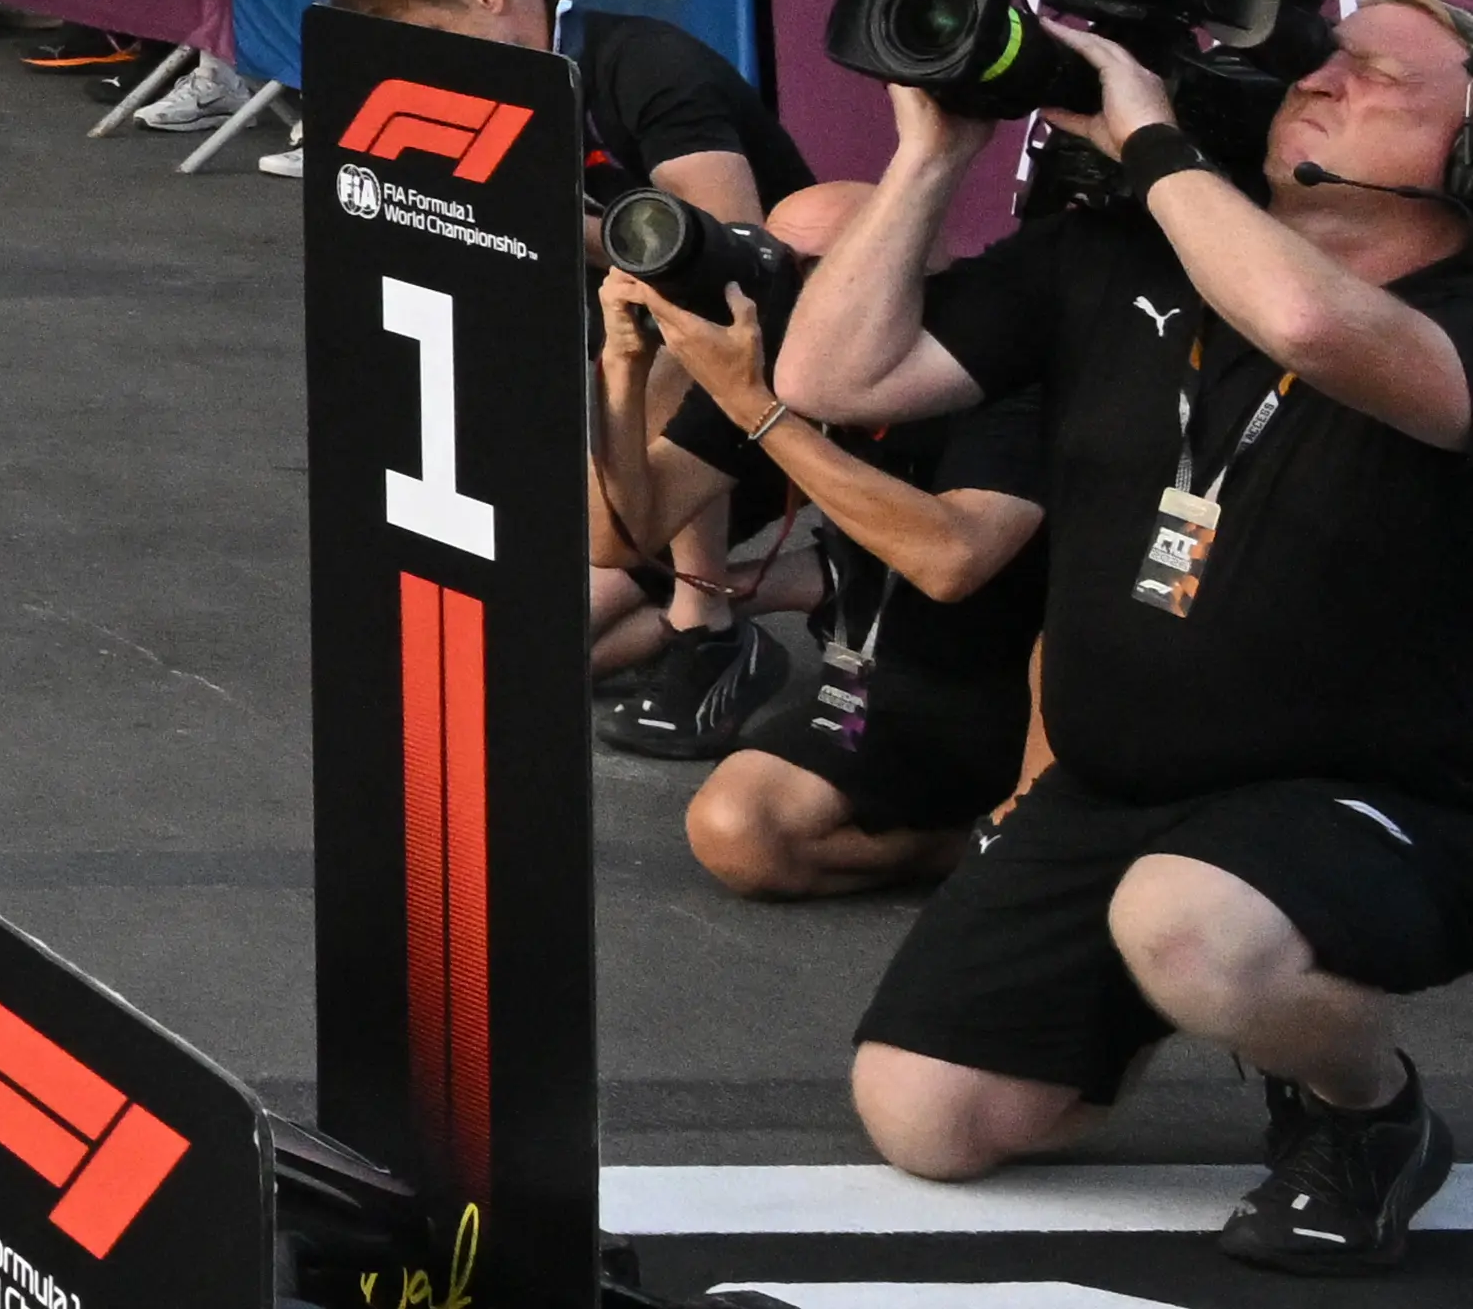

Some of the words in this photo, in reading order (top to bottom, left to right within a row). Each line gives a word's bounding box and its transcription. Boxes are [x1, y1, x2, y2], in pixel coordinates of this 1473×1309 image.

[383, 182, 406, 206] FIA
[407, 188, 465, 221] Formula
[465, 203, 476, 223] 1
[385, 202, 425, 232] World
[425, 217, 527, 259] Championship
[382, 275, 496, 560] 1
